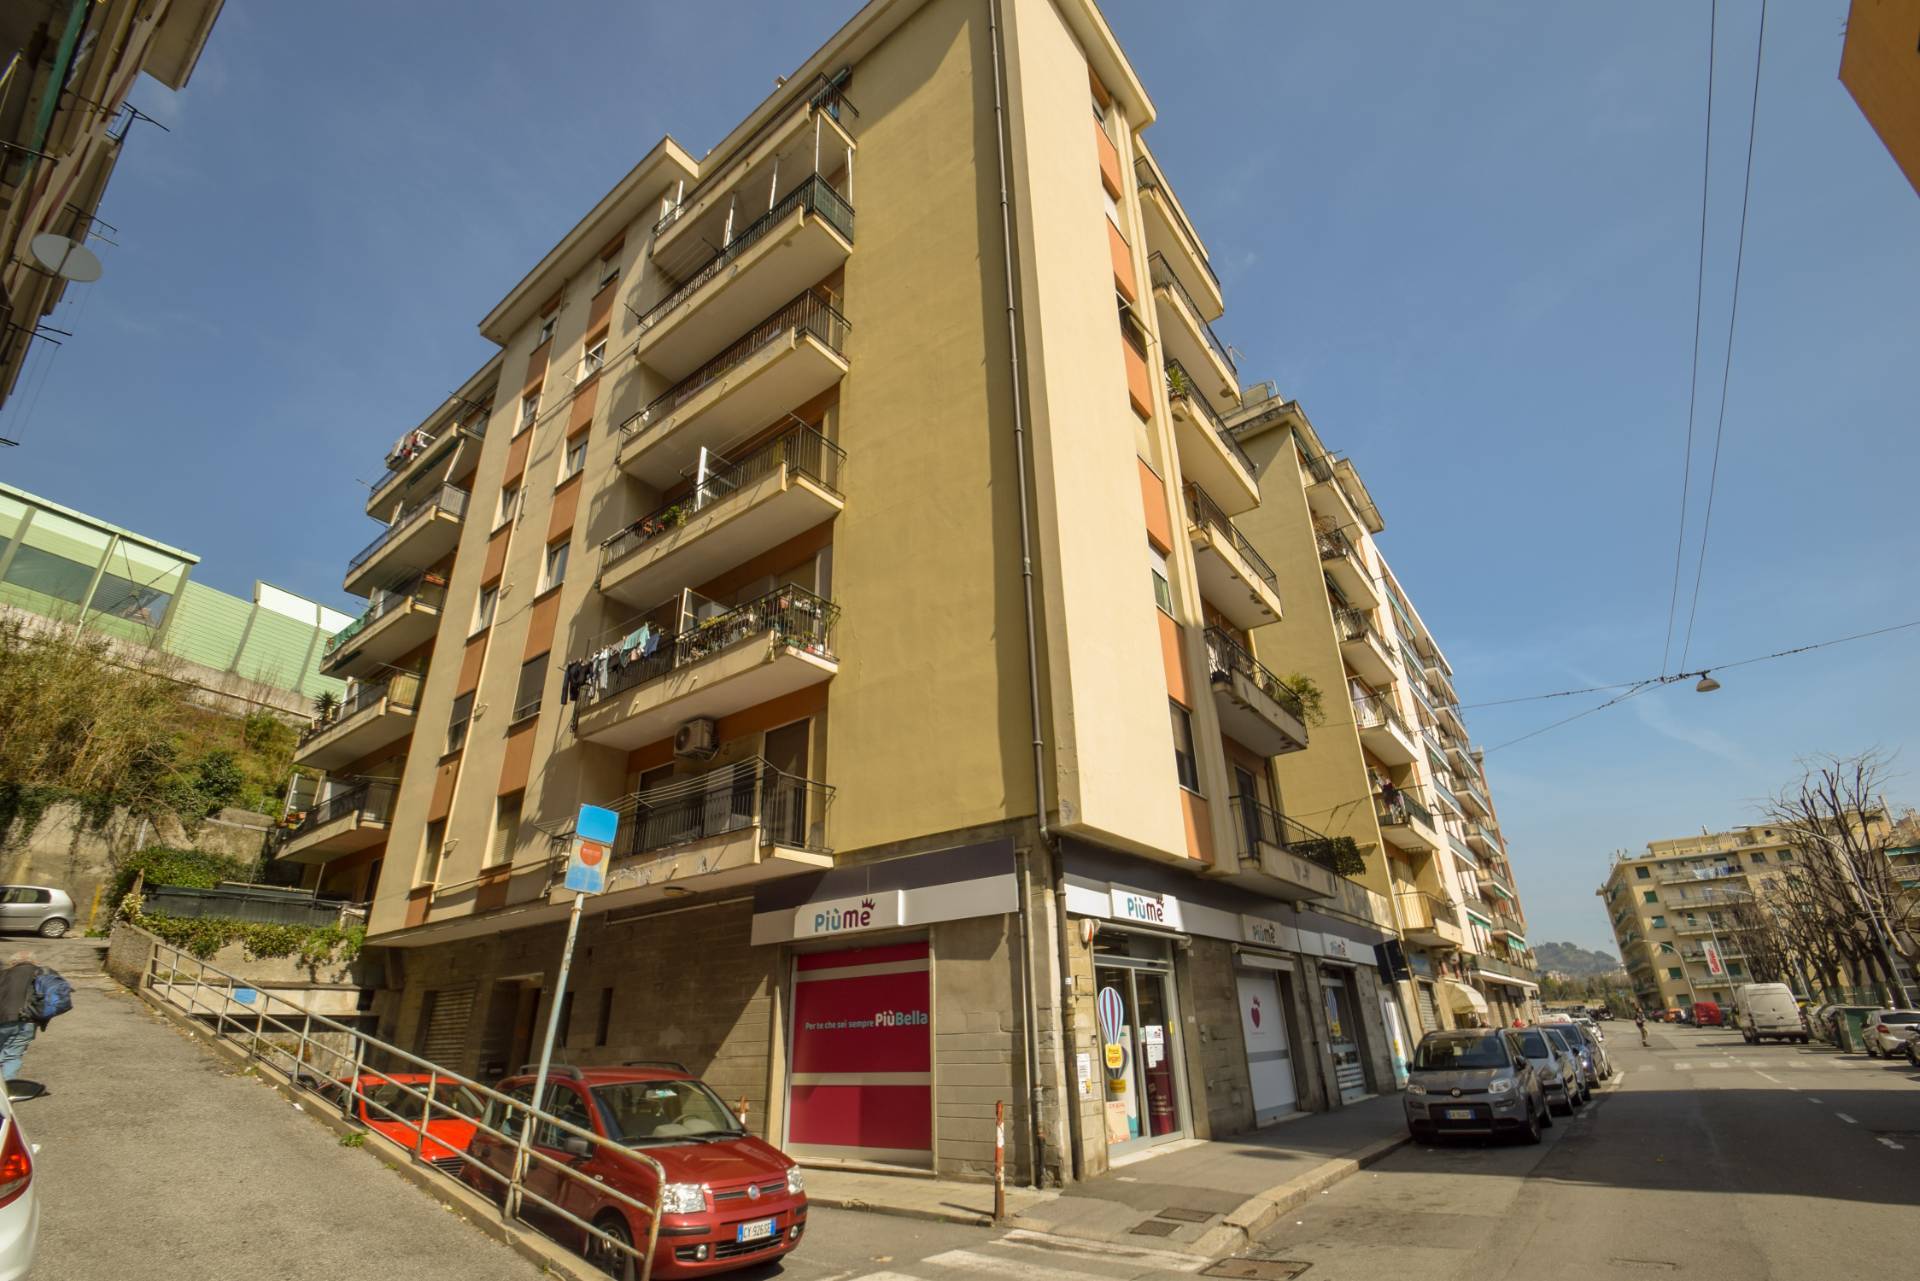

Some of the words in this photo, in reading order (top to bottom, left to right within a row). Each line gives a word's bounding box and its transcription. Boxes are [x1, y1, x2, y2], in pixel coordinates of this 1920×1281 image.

[805, 1022, 816, 1030] Per
[824, 1021, 836, 1029] che
[848, 1020, 874, 1029] sempre
